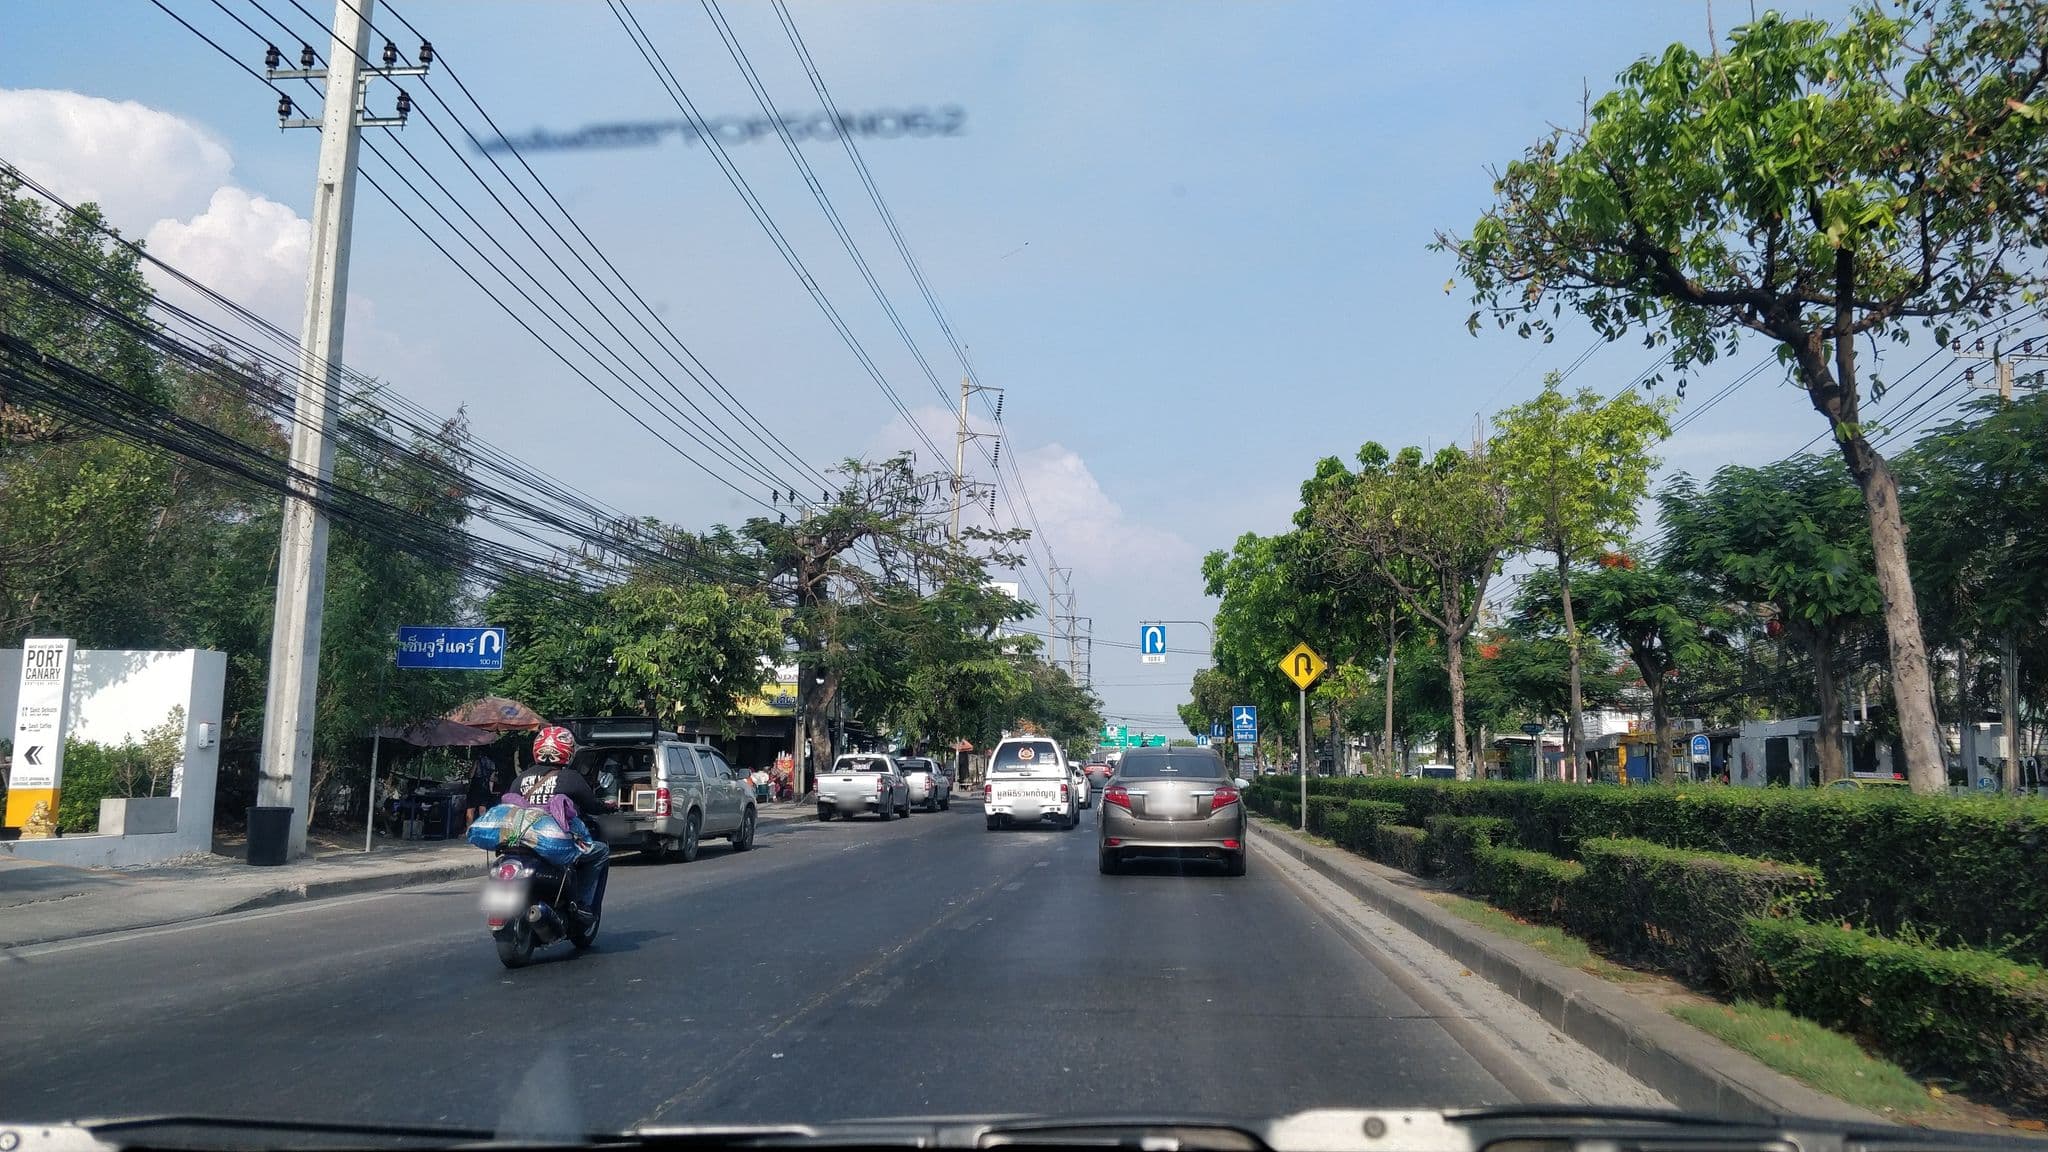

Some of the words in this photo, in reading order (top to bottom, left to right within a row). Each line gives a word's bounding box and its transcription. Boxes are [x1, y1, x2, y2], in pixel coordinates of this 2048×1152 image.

[27, 649, 63, 668] PORT
[25, 668, 61, 680] CANARY
[520, 775, 538, 788] NEW
[544, 785, 556, 794] ST
